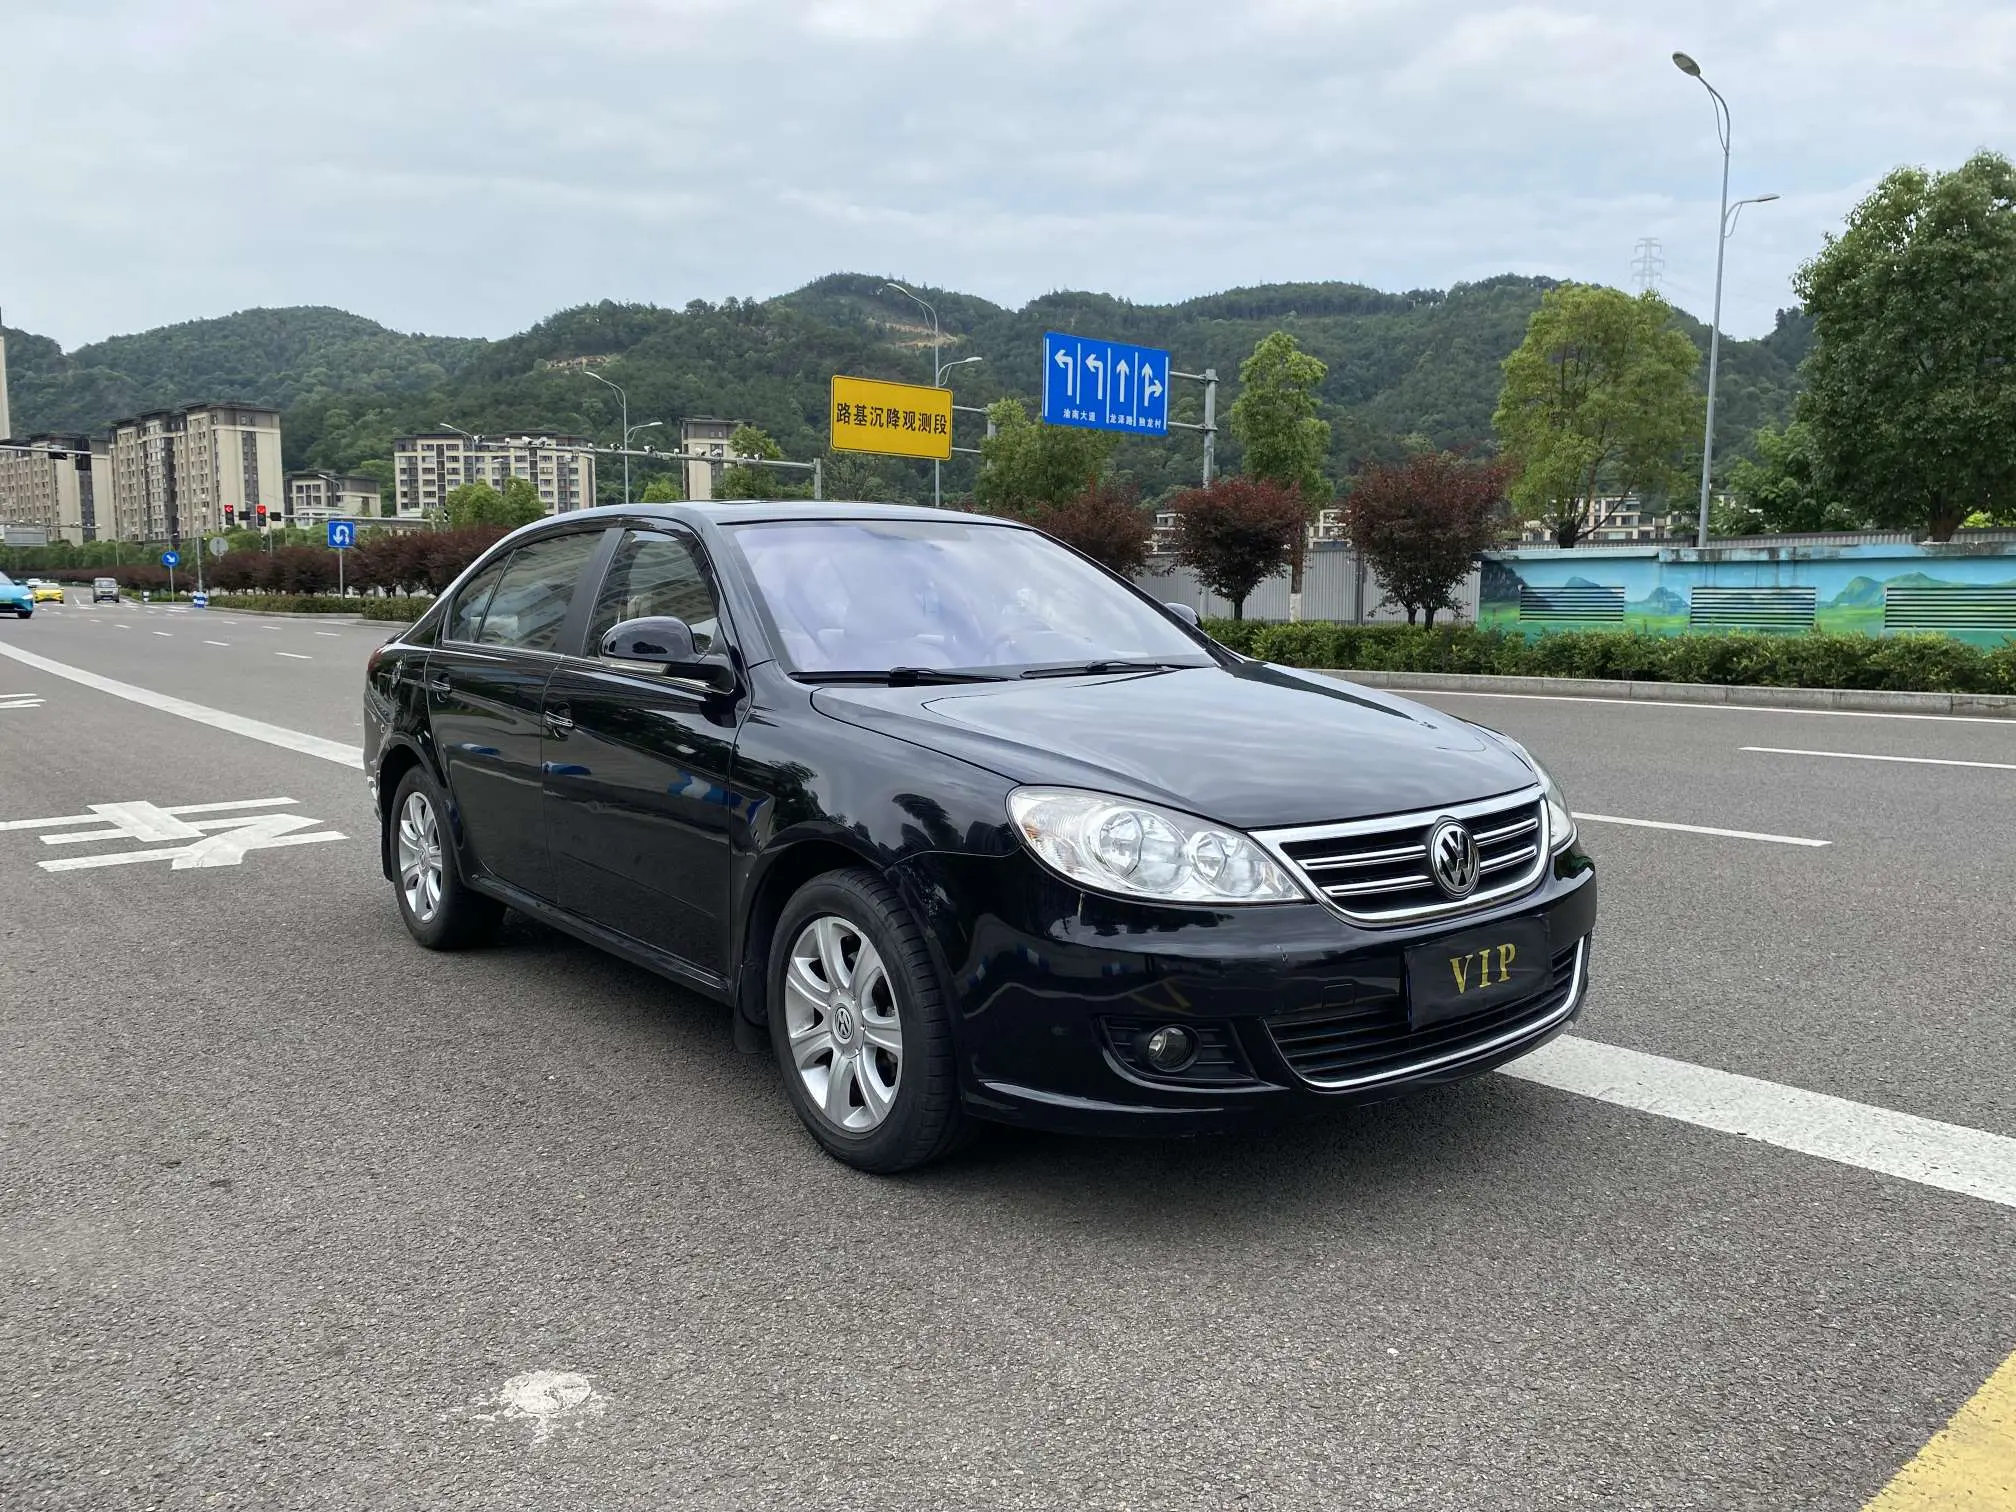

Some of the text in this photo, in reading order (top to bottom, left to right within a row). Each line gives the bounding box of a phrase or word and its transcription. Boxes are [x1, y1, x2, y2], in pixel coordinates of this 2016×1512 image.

[836, 402, 948, 435] 路基沉降观测段
[1449, 943, 1517, 994] VIP
